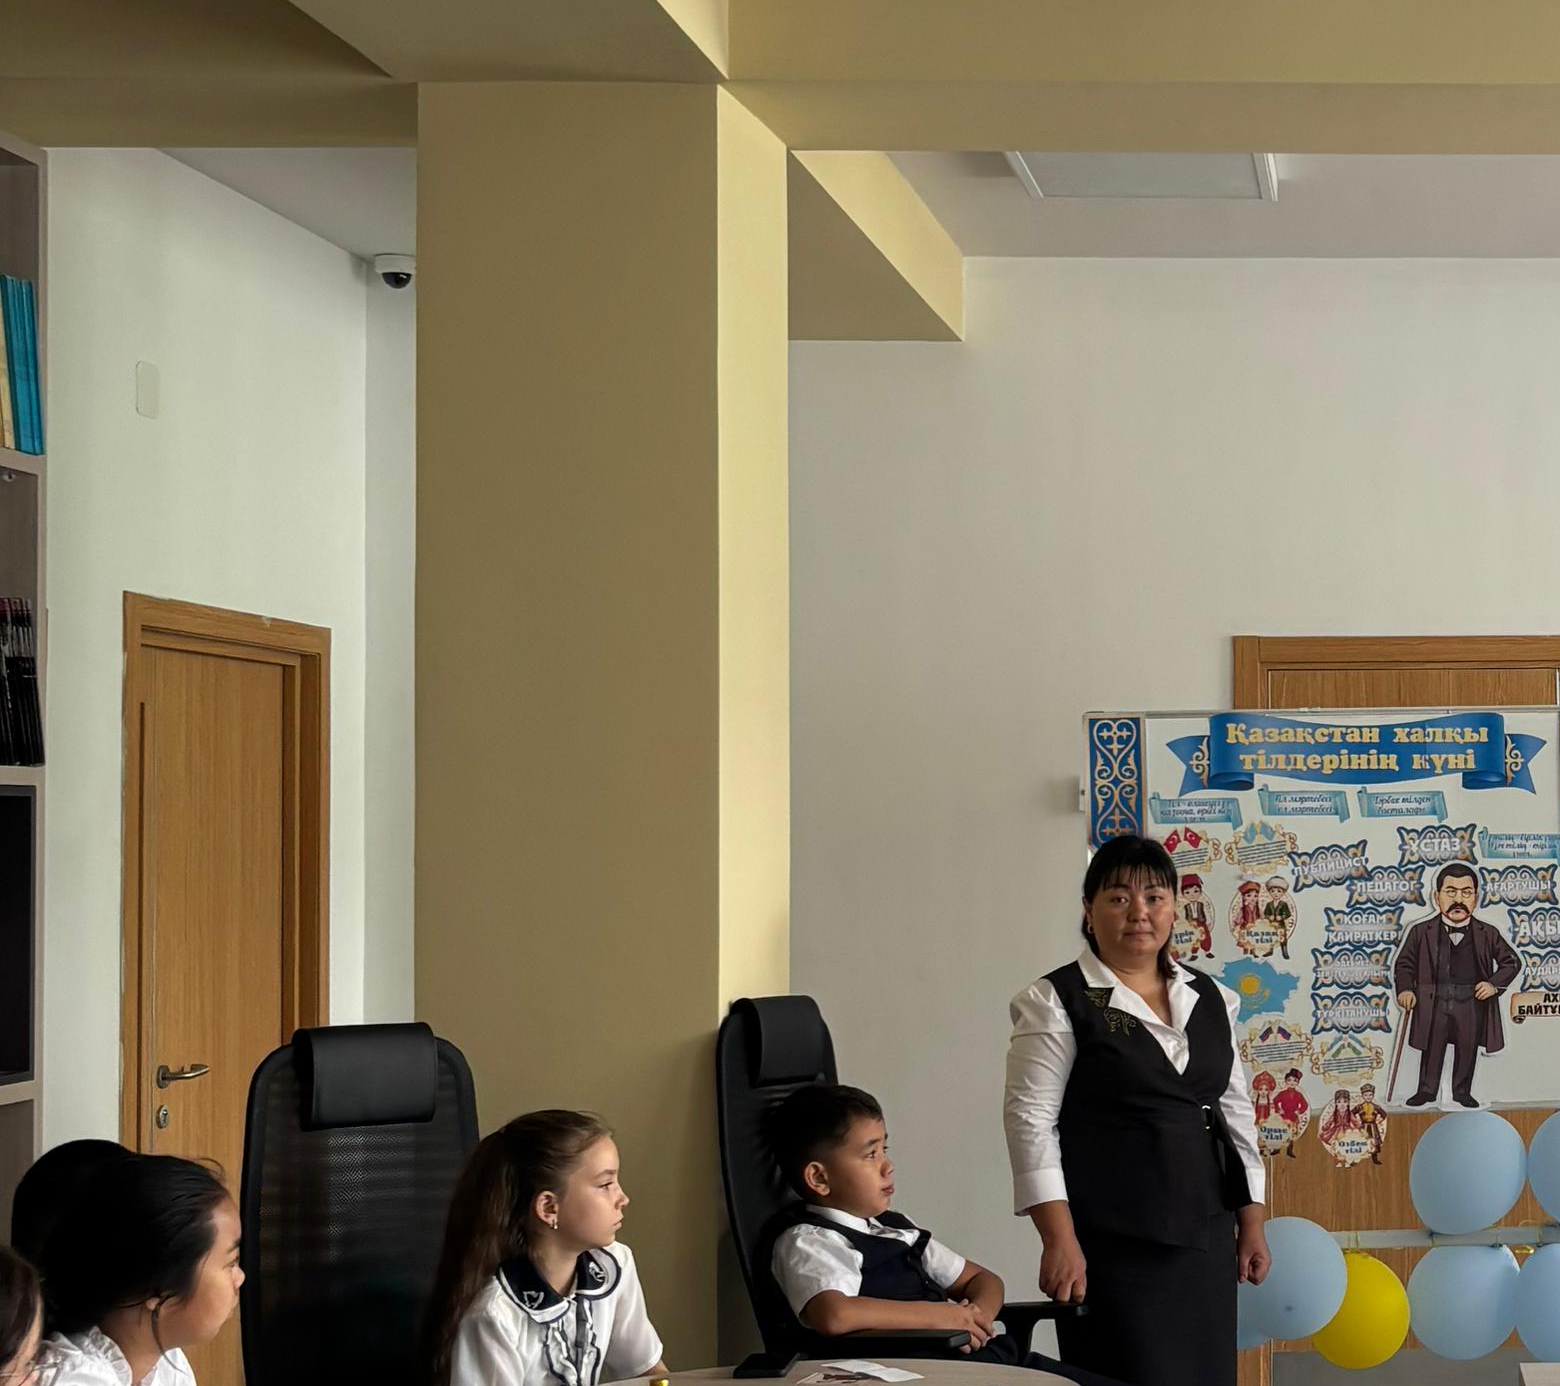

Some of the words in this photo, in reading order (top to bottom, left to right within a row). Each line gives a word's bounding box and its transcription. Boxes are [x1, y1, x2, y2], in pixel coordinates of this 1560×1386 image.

[1225, 723, 1380, 745] Қазақстан
[1392, 726, 1489, 745] халқы
[1240, 749, 1399, 774] тілдерінің
[1411, 749, 1477, 774] күні
[1294, 856, 1367, 876] ПУБЛИЦИСТ
[1357, 880, 1418, 893] ПЕДАГОГ
[1486, 880, 1551, 892] АҒАРТУШЫ
